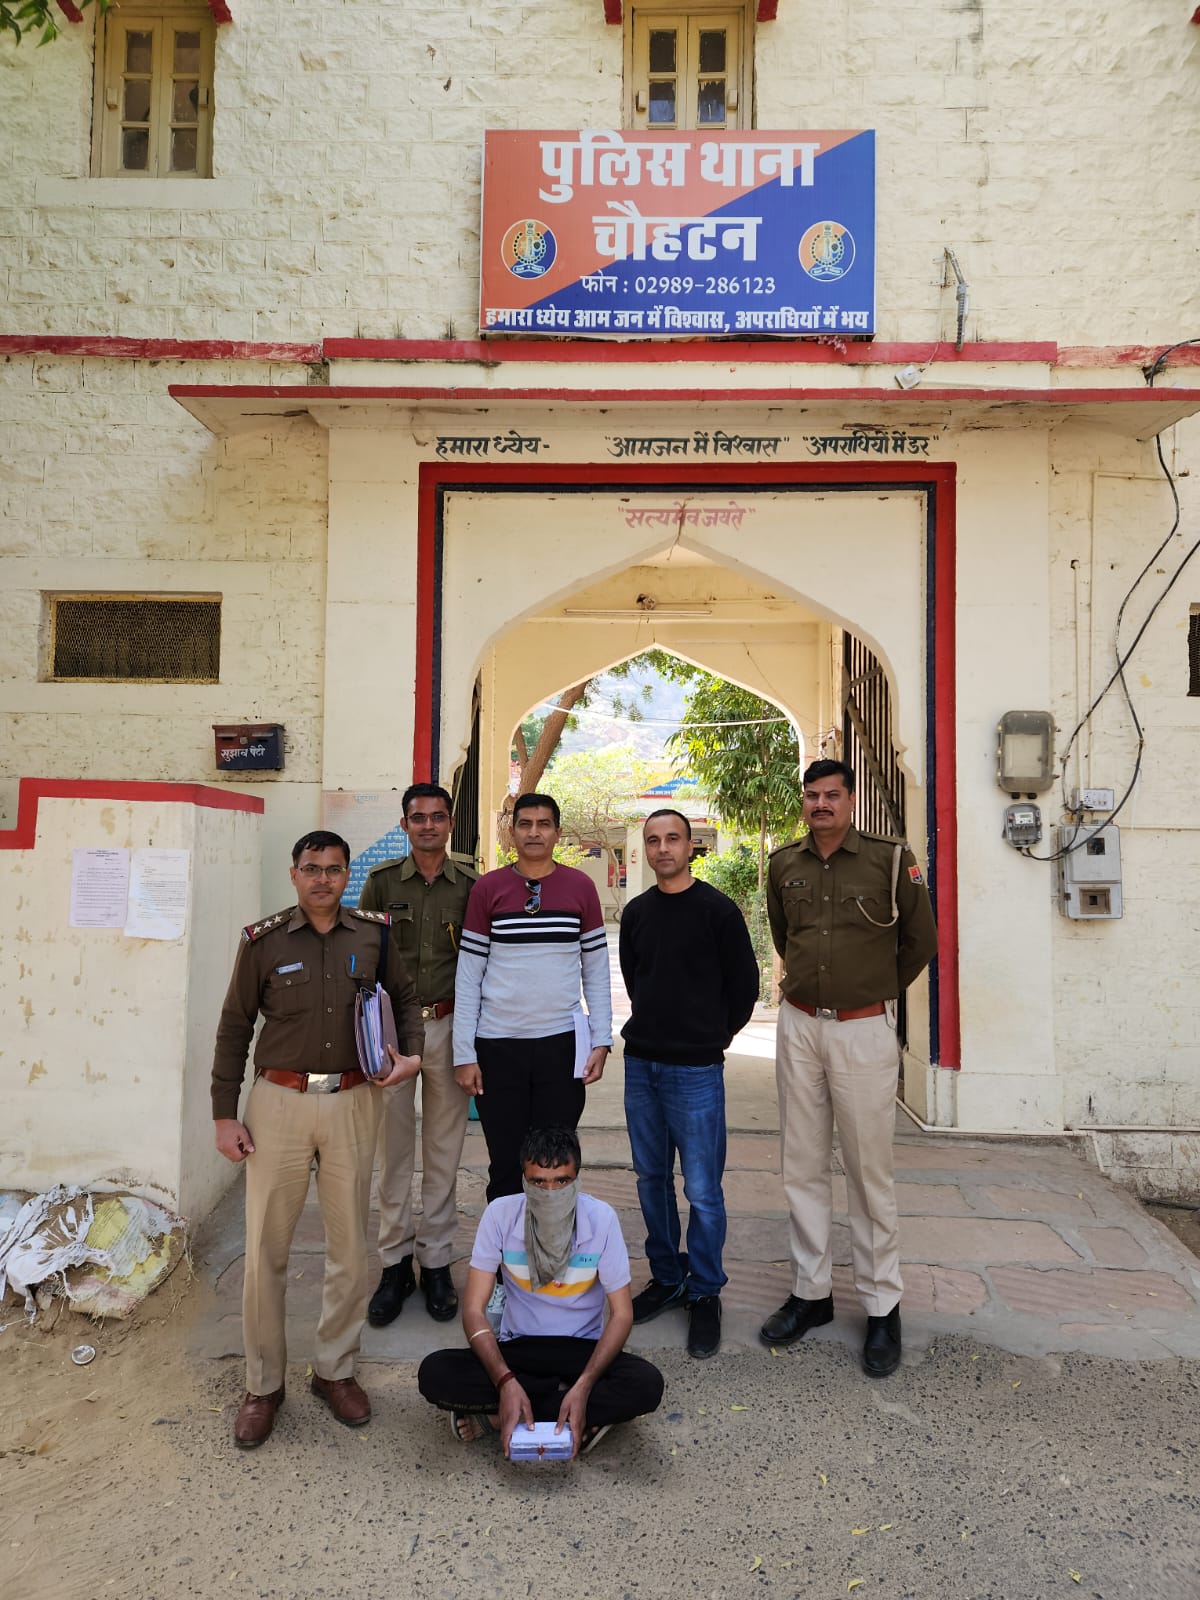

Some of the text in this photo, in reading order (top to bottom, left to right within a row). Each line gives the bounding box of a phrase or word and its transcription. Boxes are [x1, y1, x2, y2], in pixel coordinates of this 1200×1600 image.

[538, 129, 821, 204] पुलिस थाना
[591, 200, 763, 262] चौहटन
[579, 269, 618, 294] फोन
[634, 276, 776, 294] 02989-286123
[485, 304, 870, 333] हमारा ध्येय आम जन में विश्वास, अपराधियों में भय
[435, 436, 491, 461] हमारा
[693, 431, 710, 456] में
[891, 431, 907, 456] में
